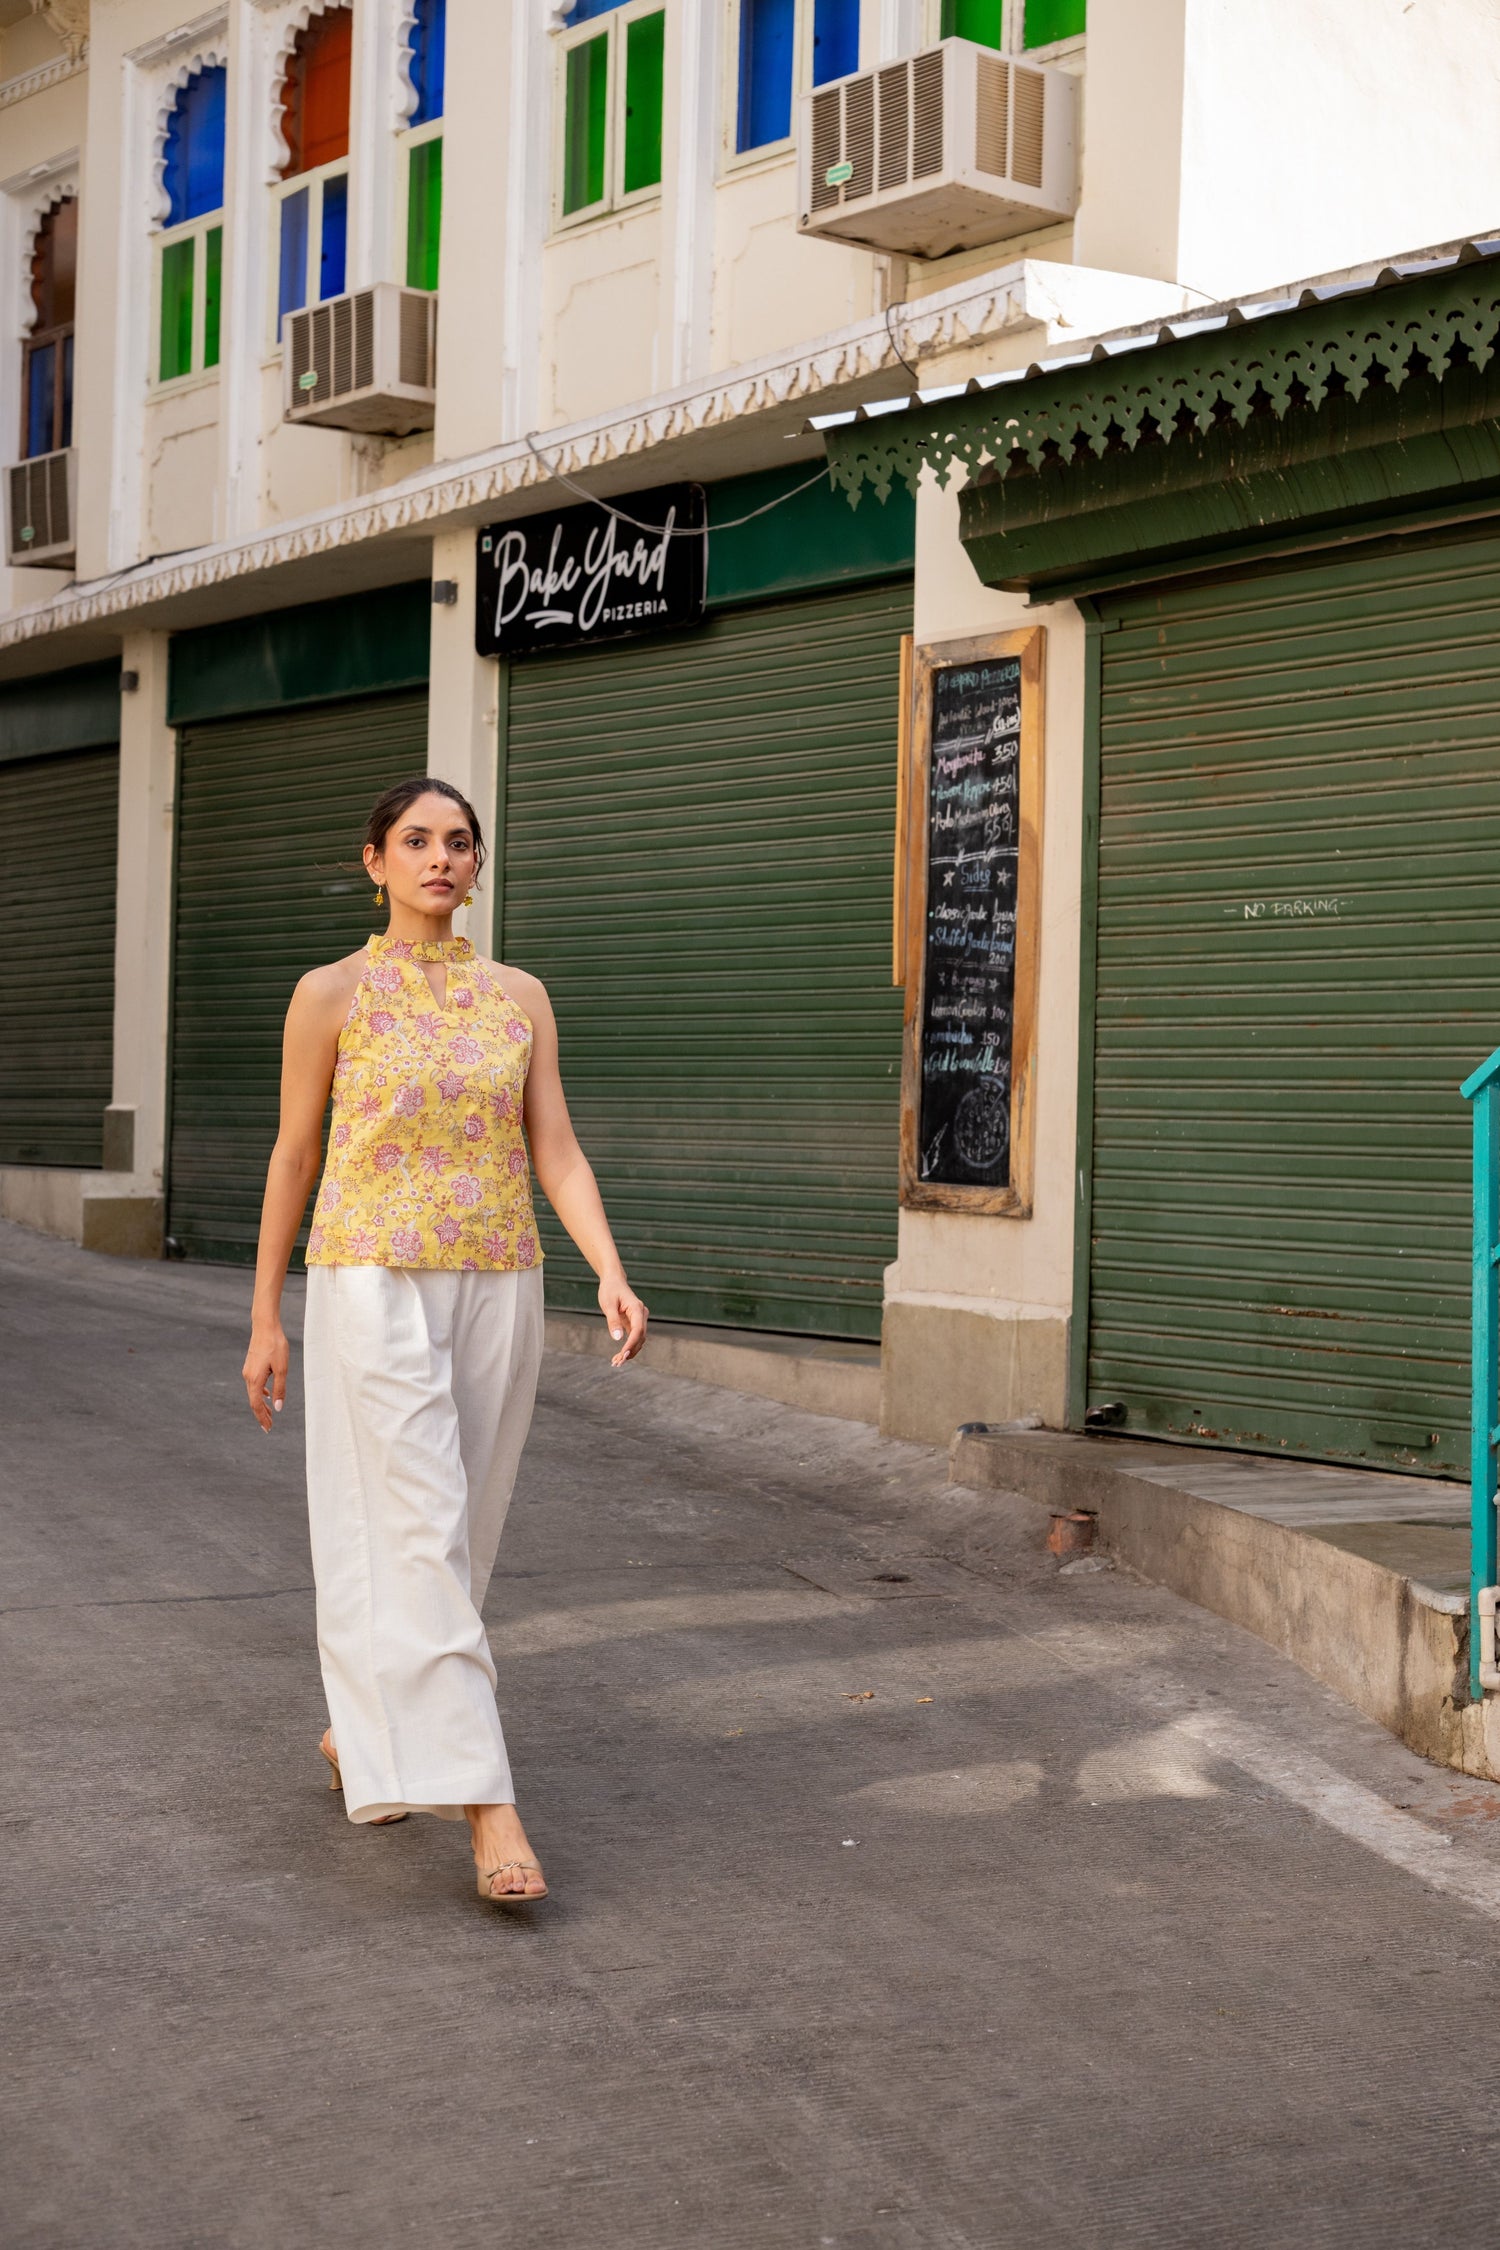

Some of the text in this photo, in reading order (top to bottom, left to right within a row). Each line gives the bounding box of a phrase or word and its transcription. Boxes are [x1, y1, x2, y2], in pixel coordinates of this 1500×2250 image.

[494, 505, 676, 638] Bake Yard
[602, 598, 668, 623] PIZZERIA
[992, 741, 1018, 763] 350
[1244, 898, 1338, 920] NO PARKING
[996, 922, 1012, 935] 150
[988, 952, 1006, 966] 200
[981, 1031, 1001, 1047] 150
